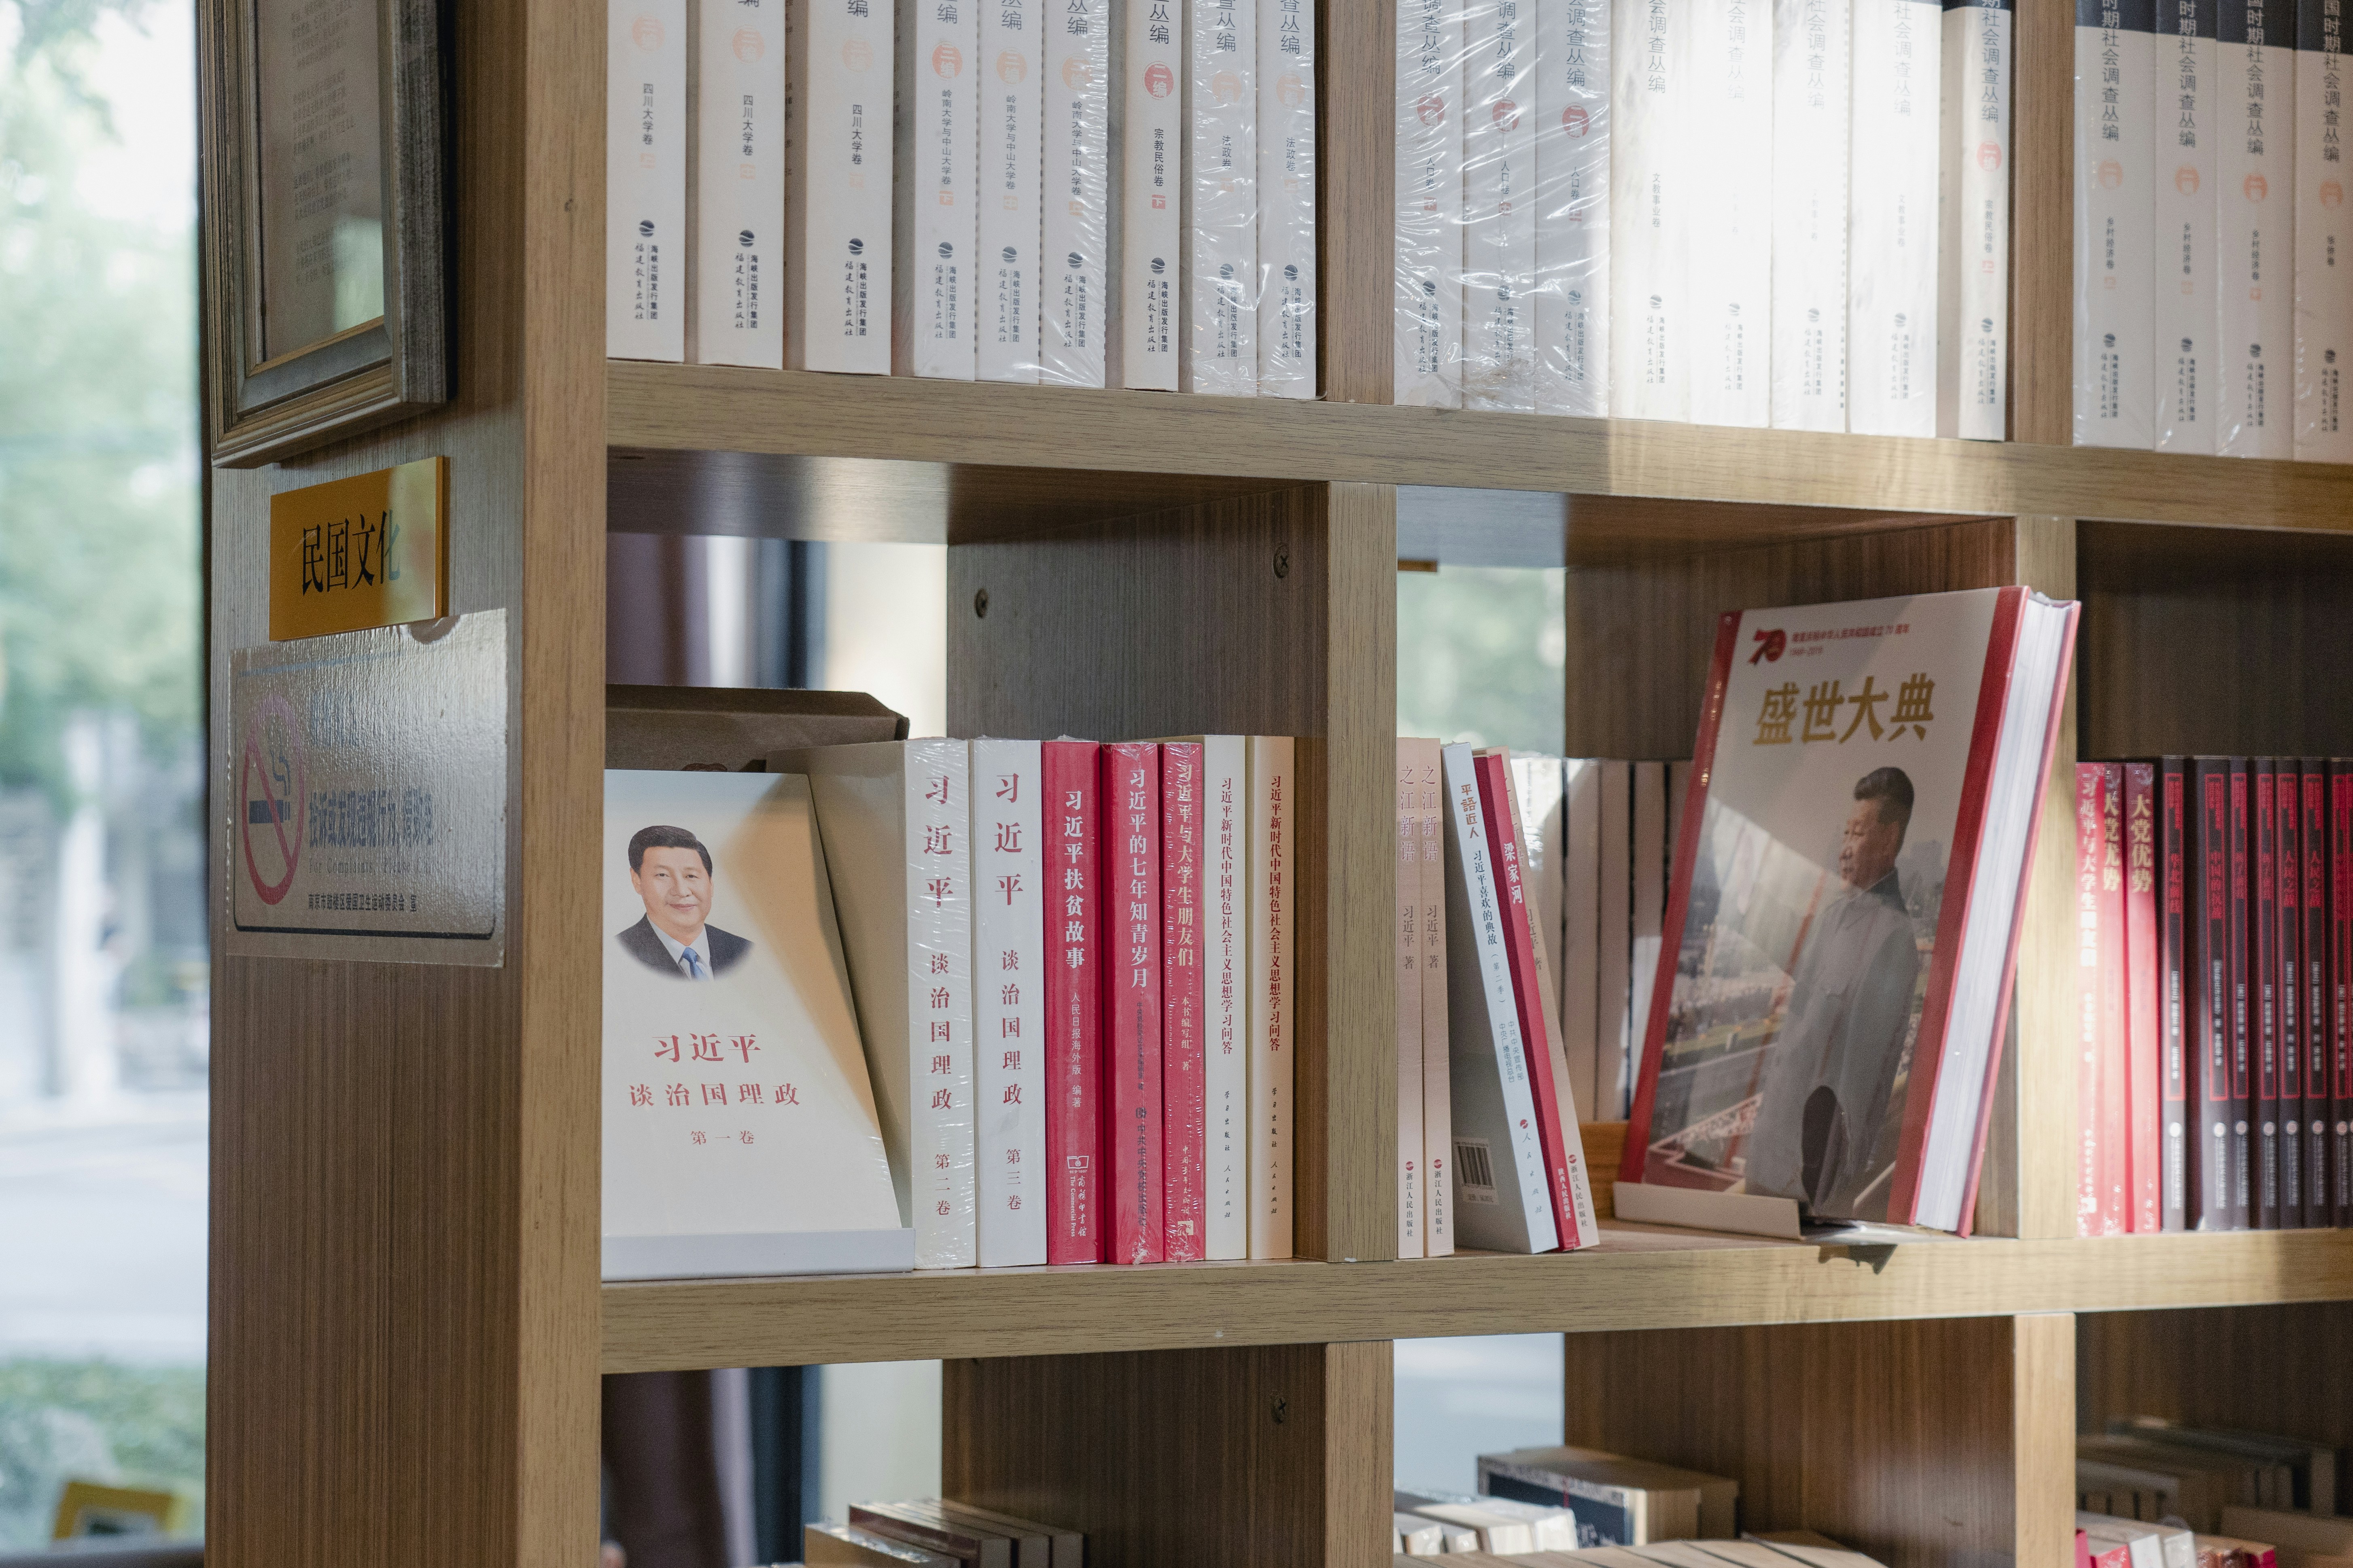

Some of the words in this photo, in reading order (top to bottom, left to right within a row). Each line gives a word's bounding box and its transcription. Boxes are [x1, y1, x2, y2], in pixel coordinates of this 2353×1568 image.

[937, 0, 957, 24] 编
[1149, 0, 1169, 44] 丛编
[643, 83, 653, 145] 四川大学卷
[743, 95, 753, 156] 四川大学卷
[852, 104, 862, 165] 四川大学卷
[942, 89, 952, 185] 岭南大学与中山大学卷
[1006, 95, 1016, 190] 岭南大学与中山大学卷
[1072, 101, 1082, 195] 岭南大学与中山大学卷
[1154, 128, 1164, 187] 宗教民俗卷
[1222, 135, 1232, 170] 法政卷
[1286, 136, 1296, 172] 法政卷
[1426, 156, 1435, 190] 人口卷
[1501, 161, 1510, 195] 人口卷
[1570, 166, 1580, 200] 人口卷
[1652, 172, 1661, 229] 文教事业卷
[935, 265, 944, 339] 福建教育出版社
[1148, 280, 1156, 352] 福建教育出版社
[303, 509, 401, 596] 民国文化
[1753, 673, 1936, 746] 盛世大典
[923, 776, 953, 908] 习近平
[995, 773, 1023, 906] 习近平
[1400, 766, 1415, 861] 之江新语
[1421, 766, 1438, 861] 之江新语
[2131, 794, 2152, 893] 大党优势
[1064, 790, 1085, 969] 习近平扶贫故事
[1128, 769, 1148, 988] 习近平的七年知青岁月
[1177, 765, 1193, 966] 习近平与大学生朋友们
[1504, 842, 1523, 904] 梁家河
[1221, 778, 1233, 1055] 习近平新时代中国特色社会主义思想学习问答
[1269, 776, 1282, 1051] 习近平新时代中国特色社会主义思想学习问答
[1403, 906, 1415, 947] 习近平
[1427, 905, 1439, 945] 习近平
[1474, 850, 1498, 945] 习近平喜欢的典故
[1403, 956, 1415, 970] 著
[1428, 956, 1439, 969] 著
[652, 1033, 761, 1063] 习近平
[929, 953, 952, 1110] 谈治国理政
[1001, 950, 1022, 1105] 谈治国理政
[1071, 993, 1082, 1075] 人民日报海外版
[1181, 997, 1190, 1049] 本书编写组
[628, 1083, 800, 1107] 谈治国理政
[1072, 1085, 1082, 1108] 编著
[1182, 1061, 1190, 1071] 著
[690, 1131, 755, 1145] 第一卷
[935, 1153, 950, 1215] 第二卷
[1006, 1149, 1022, 1210] 第三卷
[1434, 1171, 1443, 1234] 浙江人民出版社
